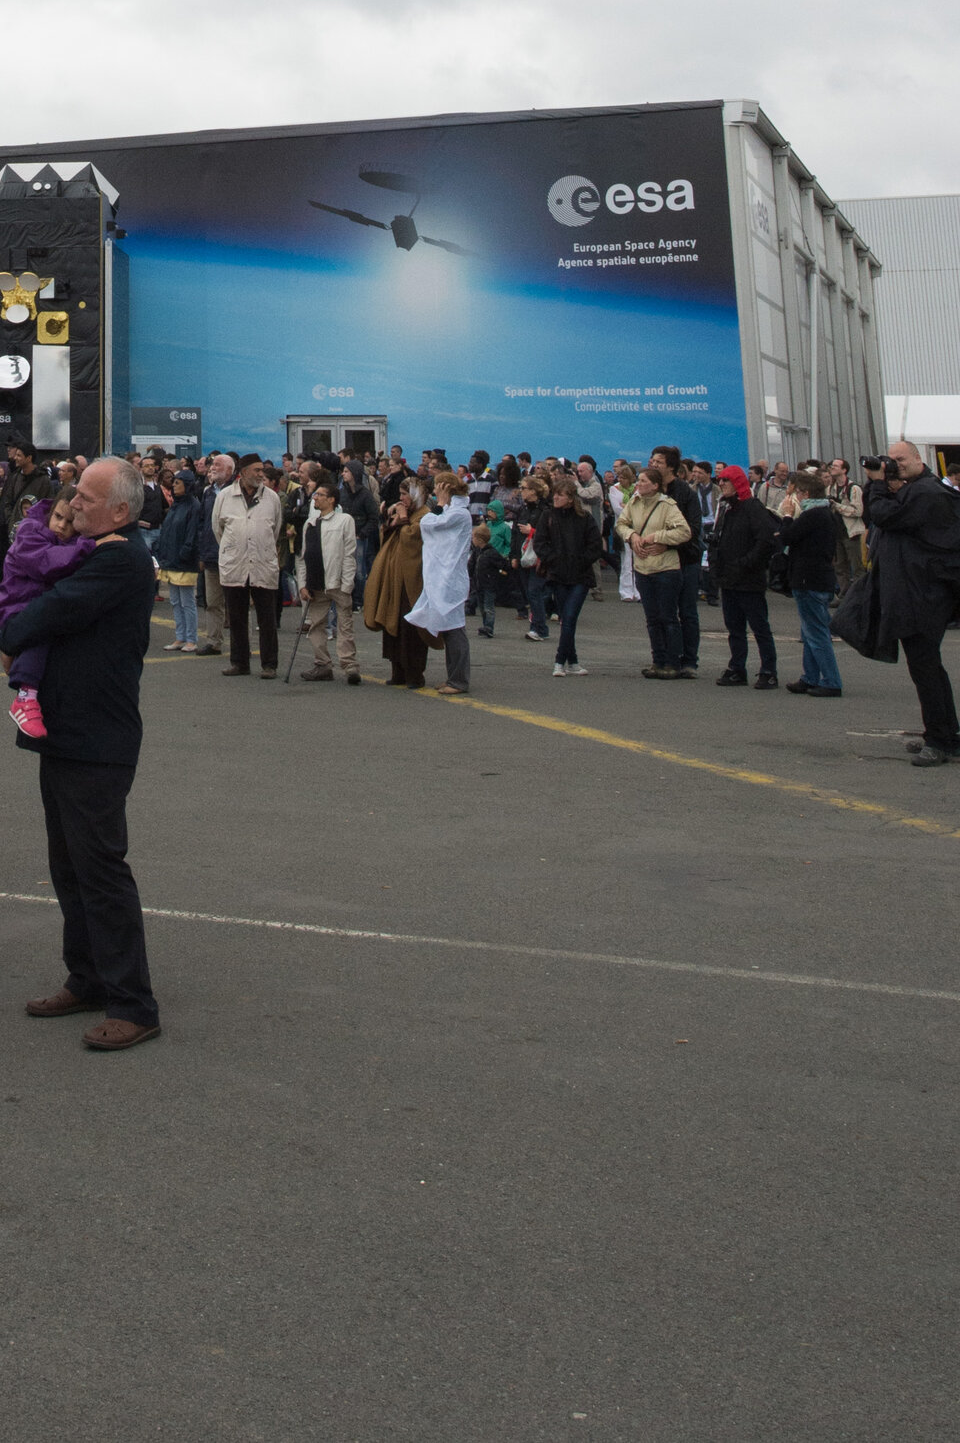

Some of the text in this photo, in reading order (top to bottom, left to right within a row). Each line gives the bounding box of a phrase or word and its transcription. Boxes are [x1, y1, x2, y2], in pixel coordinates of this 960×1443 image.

[605, 179, 695, 215] esa
[573, 238, 697, 254] European Space Agency
[557, 253, 699, 270] Agence spatiale européenne
[328, 386, 355, 398] esa
[504, 384, 708, 398] Space for Competitiveness and Growth
[575, 401, 709, 413] Compétitivité et croissance
[180, 412, 198, 420] esa
